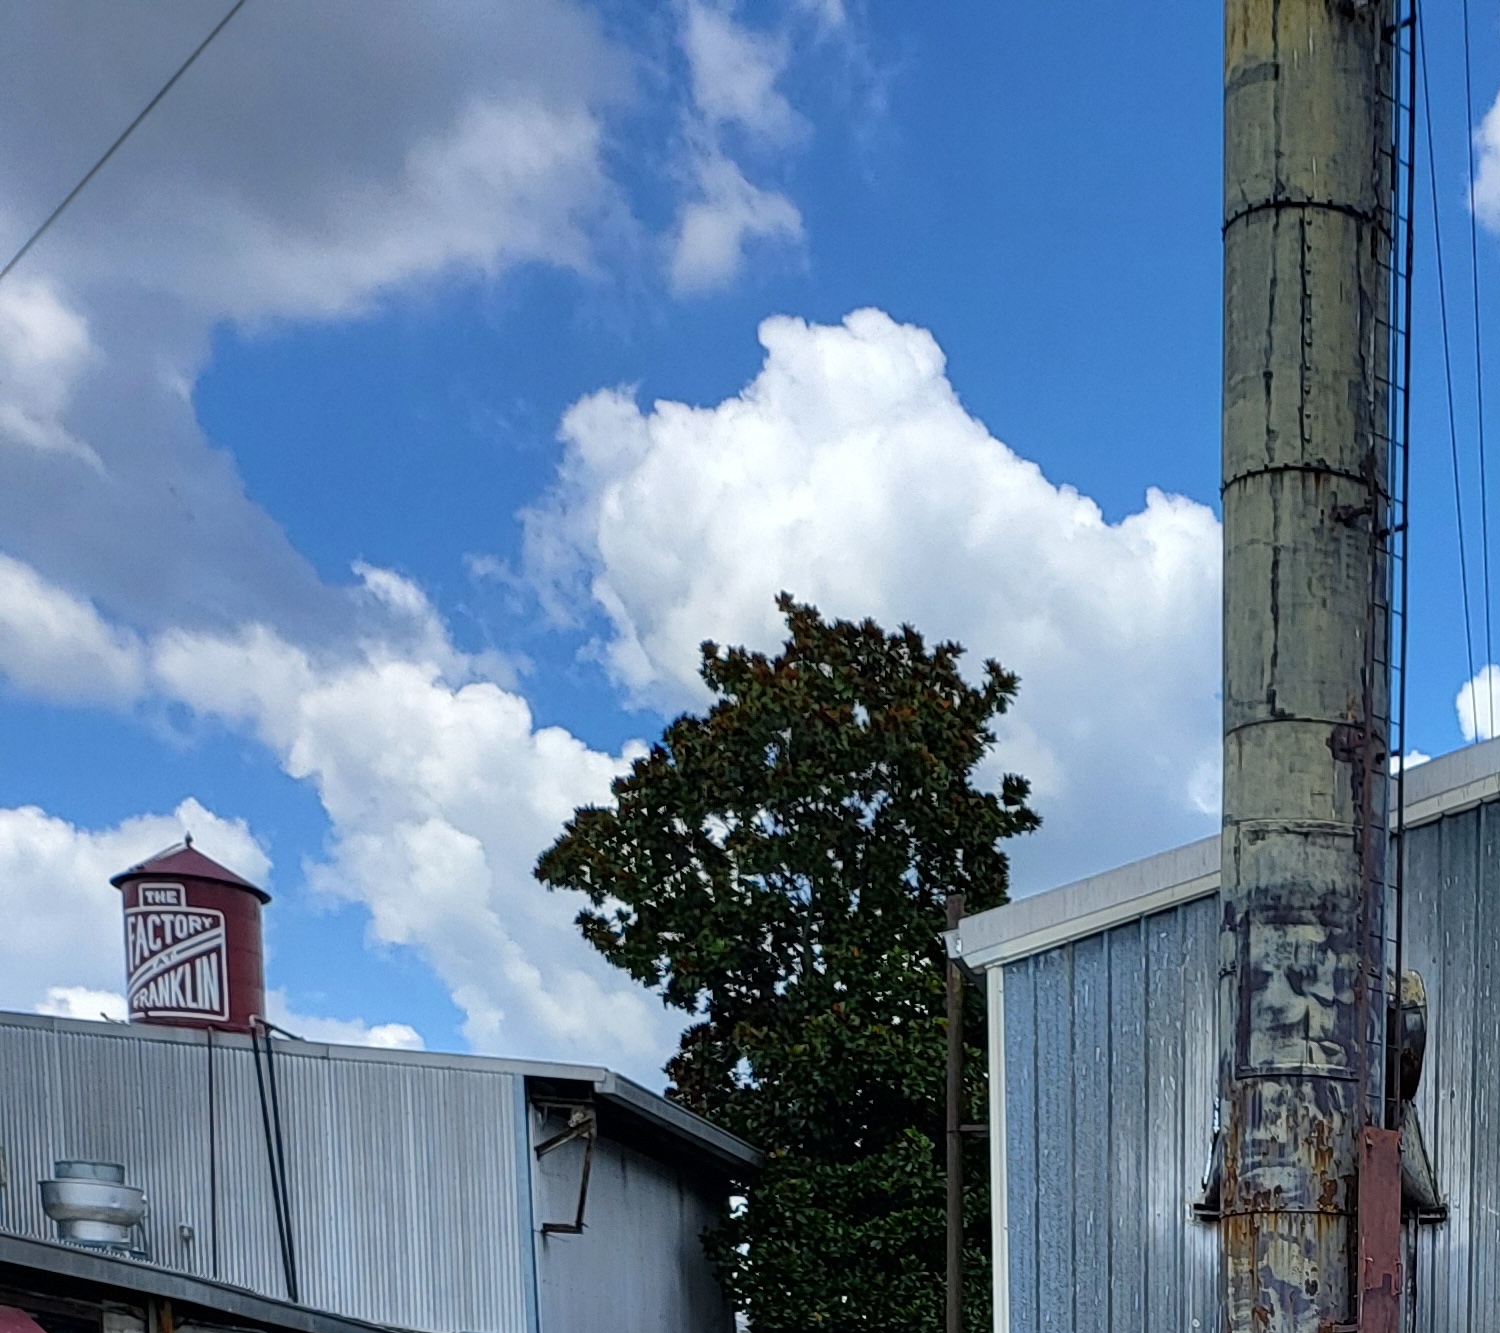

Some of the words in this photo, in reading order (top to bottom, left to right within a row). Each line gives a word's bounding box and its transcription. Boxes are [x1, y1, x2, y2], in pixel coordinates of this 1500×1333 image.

[144, 890, 178, 904] THE
[127, 913, 214, 973] FACTORY
[153, 952, 175, 969] AT
[133, 952, 220, 1012] FRANKLIN
